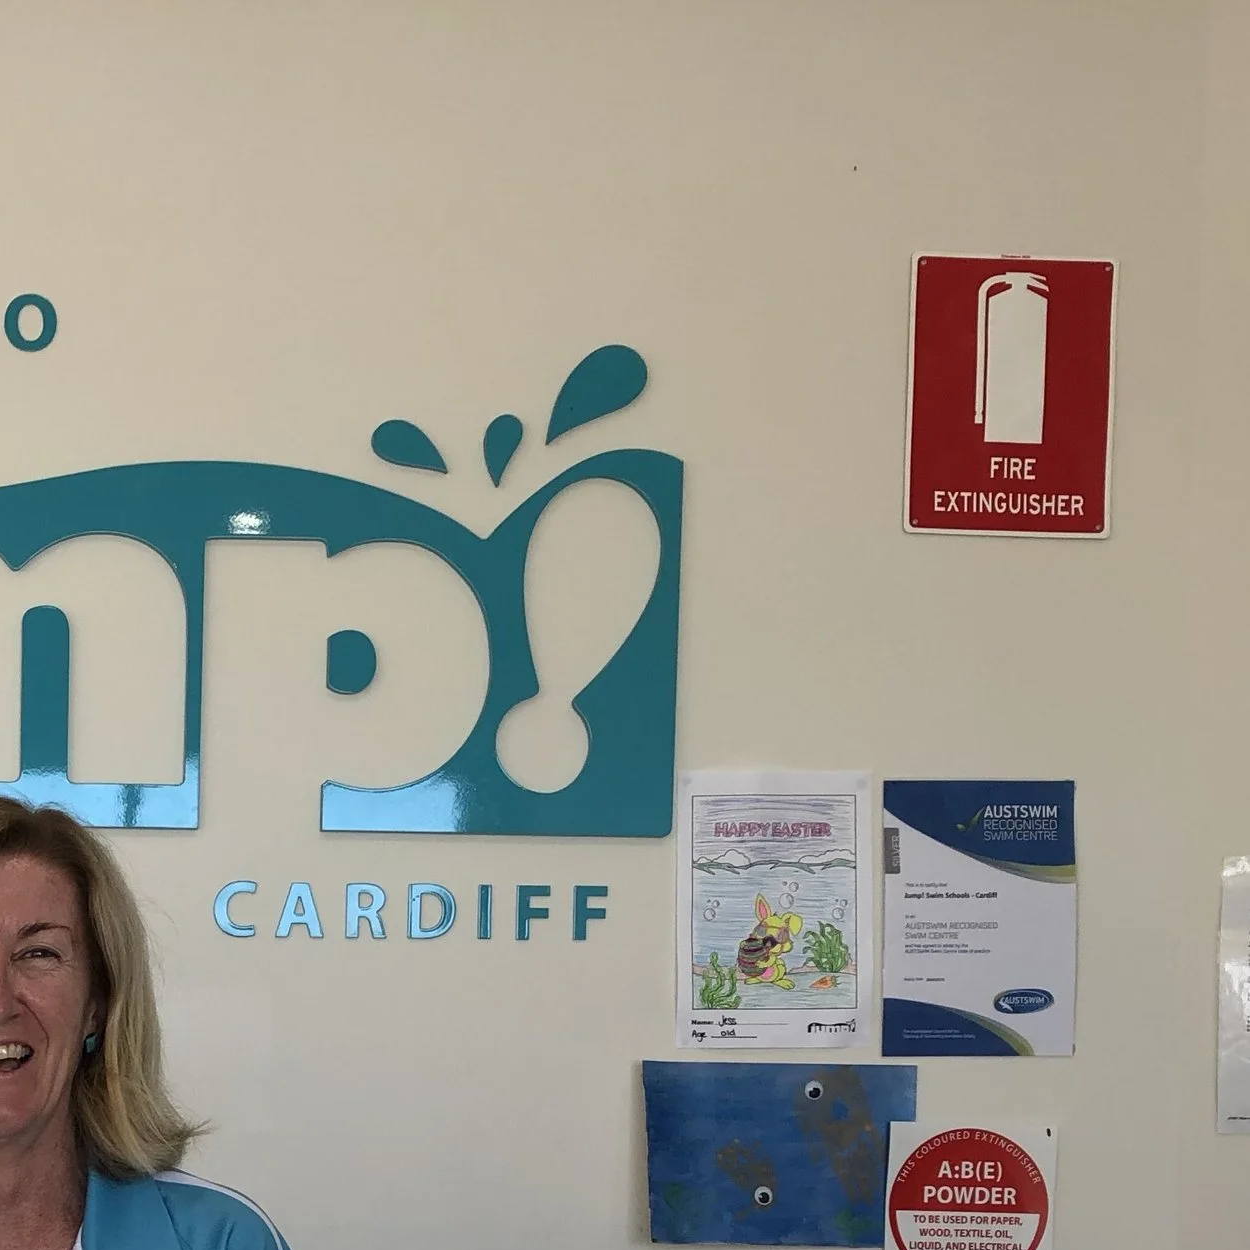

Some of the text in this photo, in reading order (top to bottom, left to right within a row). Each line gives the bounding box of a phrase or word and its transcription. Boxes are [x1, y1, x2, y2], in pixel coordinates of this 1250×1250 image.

[990, 457, 1036, 480] FIRE
[933, 491, 1085, 516] EXTINGUISHER
[984, 805, 1058, 818] AUSTSWIM
[714, 822, 831, 837] HAPPY EASTER
[984, 819, 1058, 830] RECOGNISED
[984, 831, 1058, 841] SWIM CENTRE
[892, 835, 901, 867] SILVER
[213, 880, 609, 942] CARDIFF
[1005, 996, 1045, 1004] AUSTSWIM
[692, 1029, 707, 1042] Age
[897, 1130, 1042, 1184] THIS COLOURED EXTINGUISHER
[938, 1161, 1003, 1182] A:B(E)
[923, 1186, 1017, 1205] POWDER
[913, 1215, 1023, 1226] TO BE USED FOR PAPER,
[919, 1229, 1013, 1239] WOOD, TEXTILE, OIL,
[909, 1241, 943, 1250] LIQUID,
[945, 1243, 966, 1250] AND
